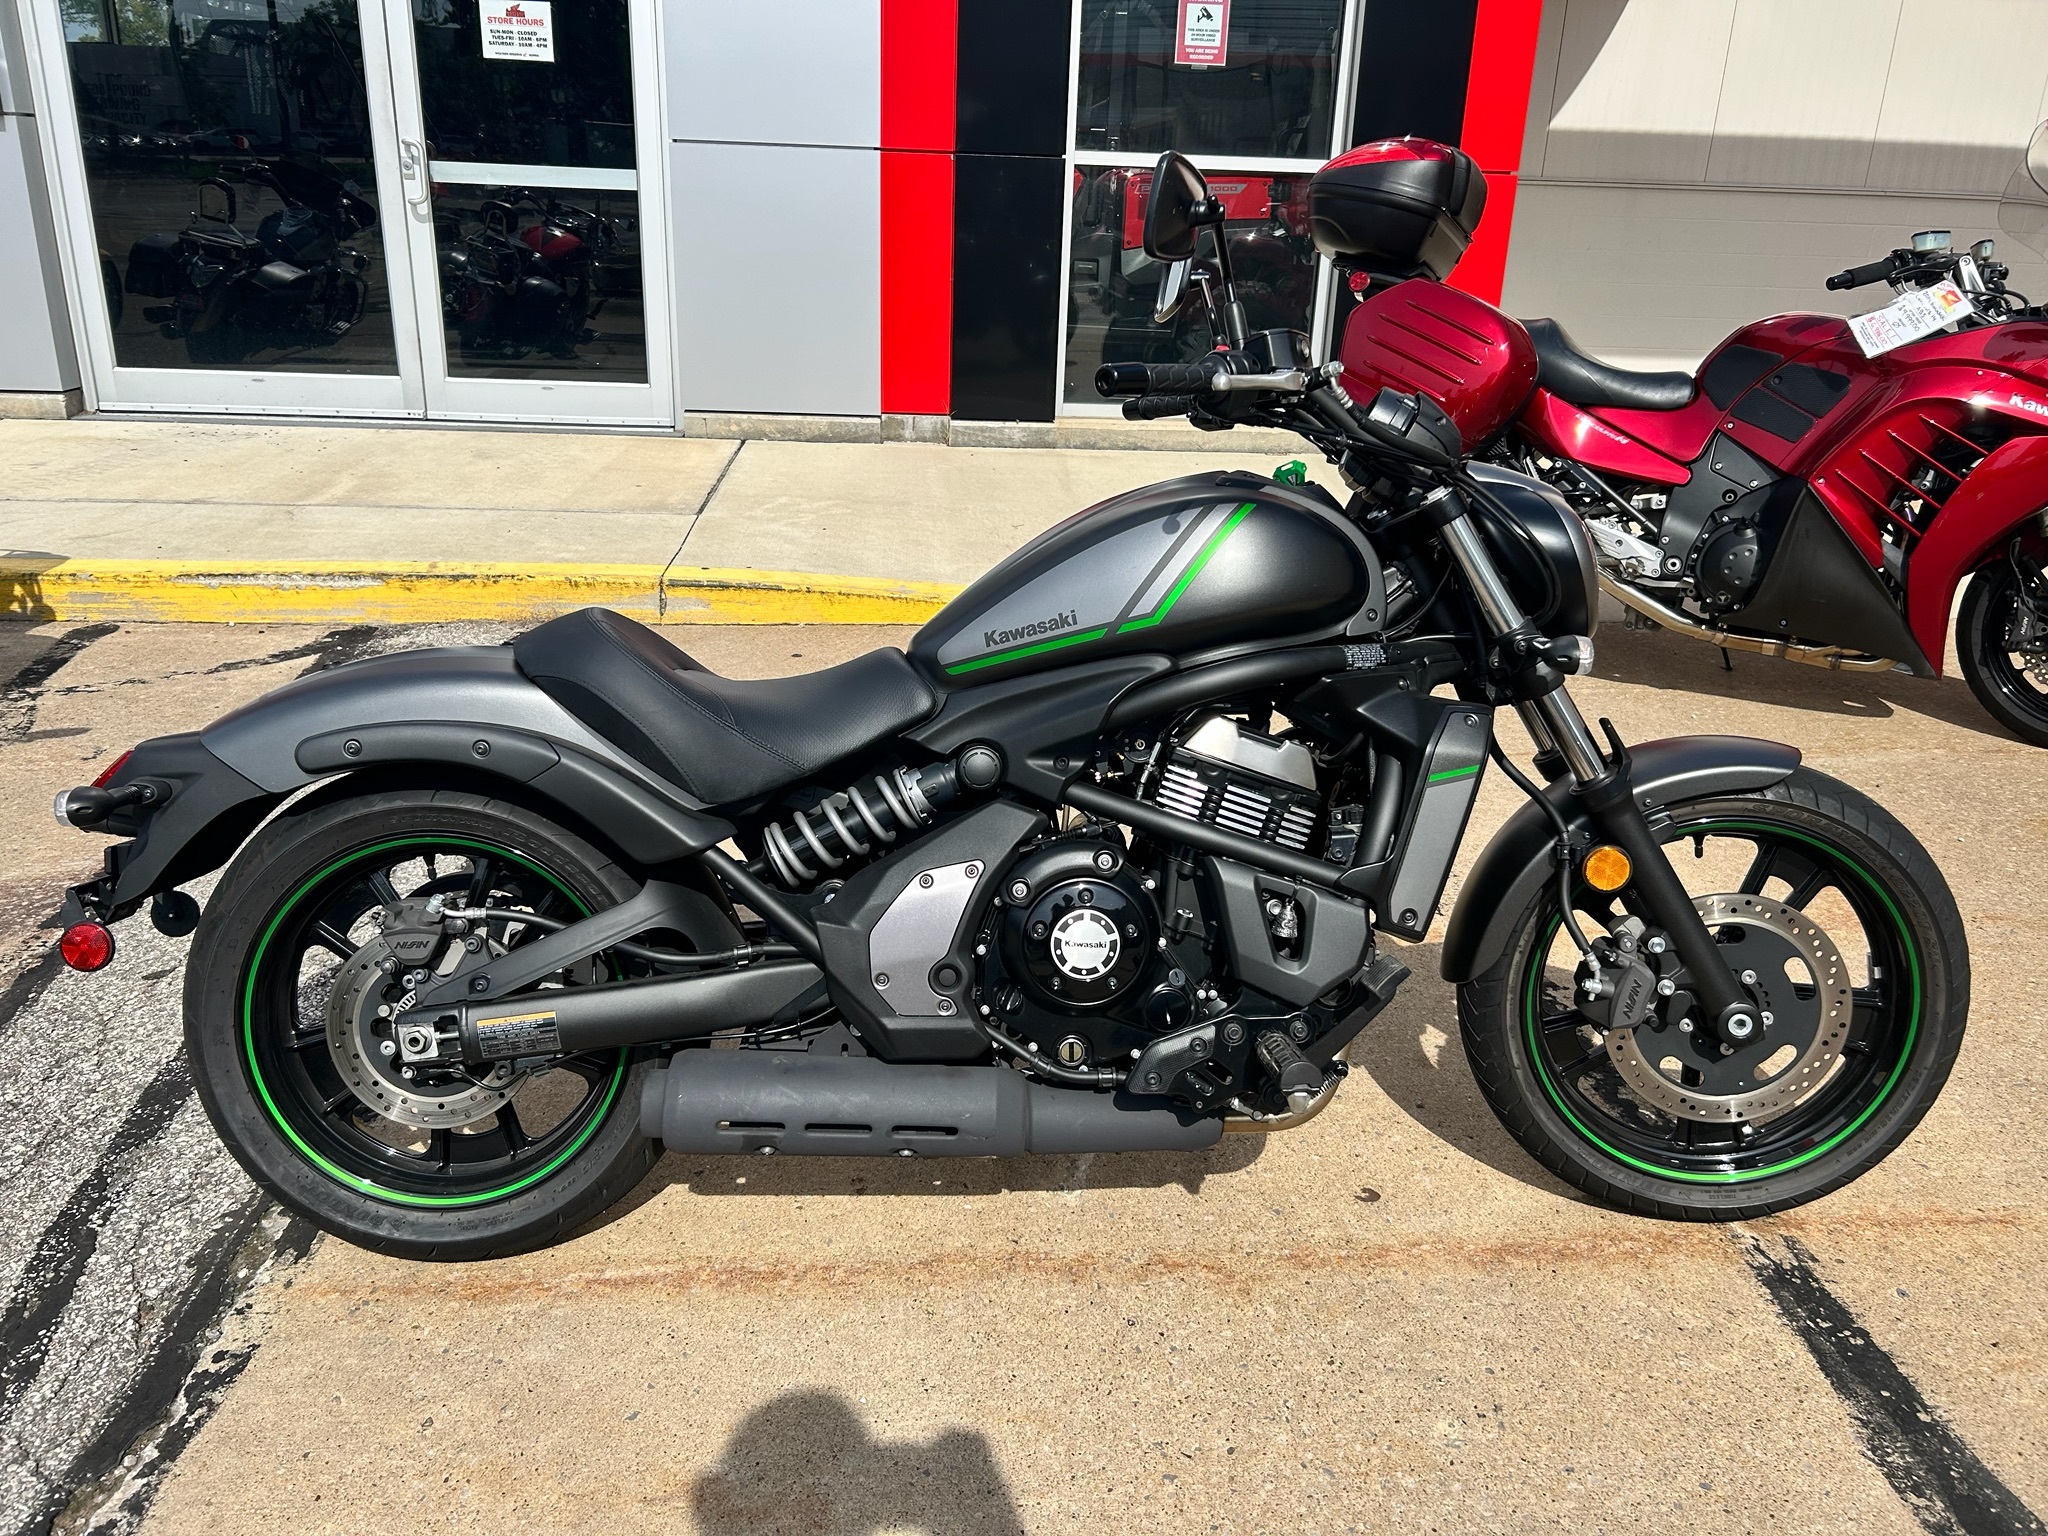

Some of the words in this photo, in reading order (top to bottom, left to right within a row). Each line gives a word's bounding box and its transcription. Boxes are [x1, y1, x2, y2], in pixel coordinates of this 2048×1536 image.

[487, 16, 514, 25] STORE
[515, 18, 544, 26] HOURS
[983, 610, 1078, 649] Kawasaki
[394, 940, 430, 950] NISSIN
[1064, 939, 1107, 951] Kawasaki
[1623, 979, 1643, 1019] NISSIN
